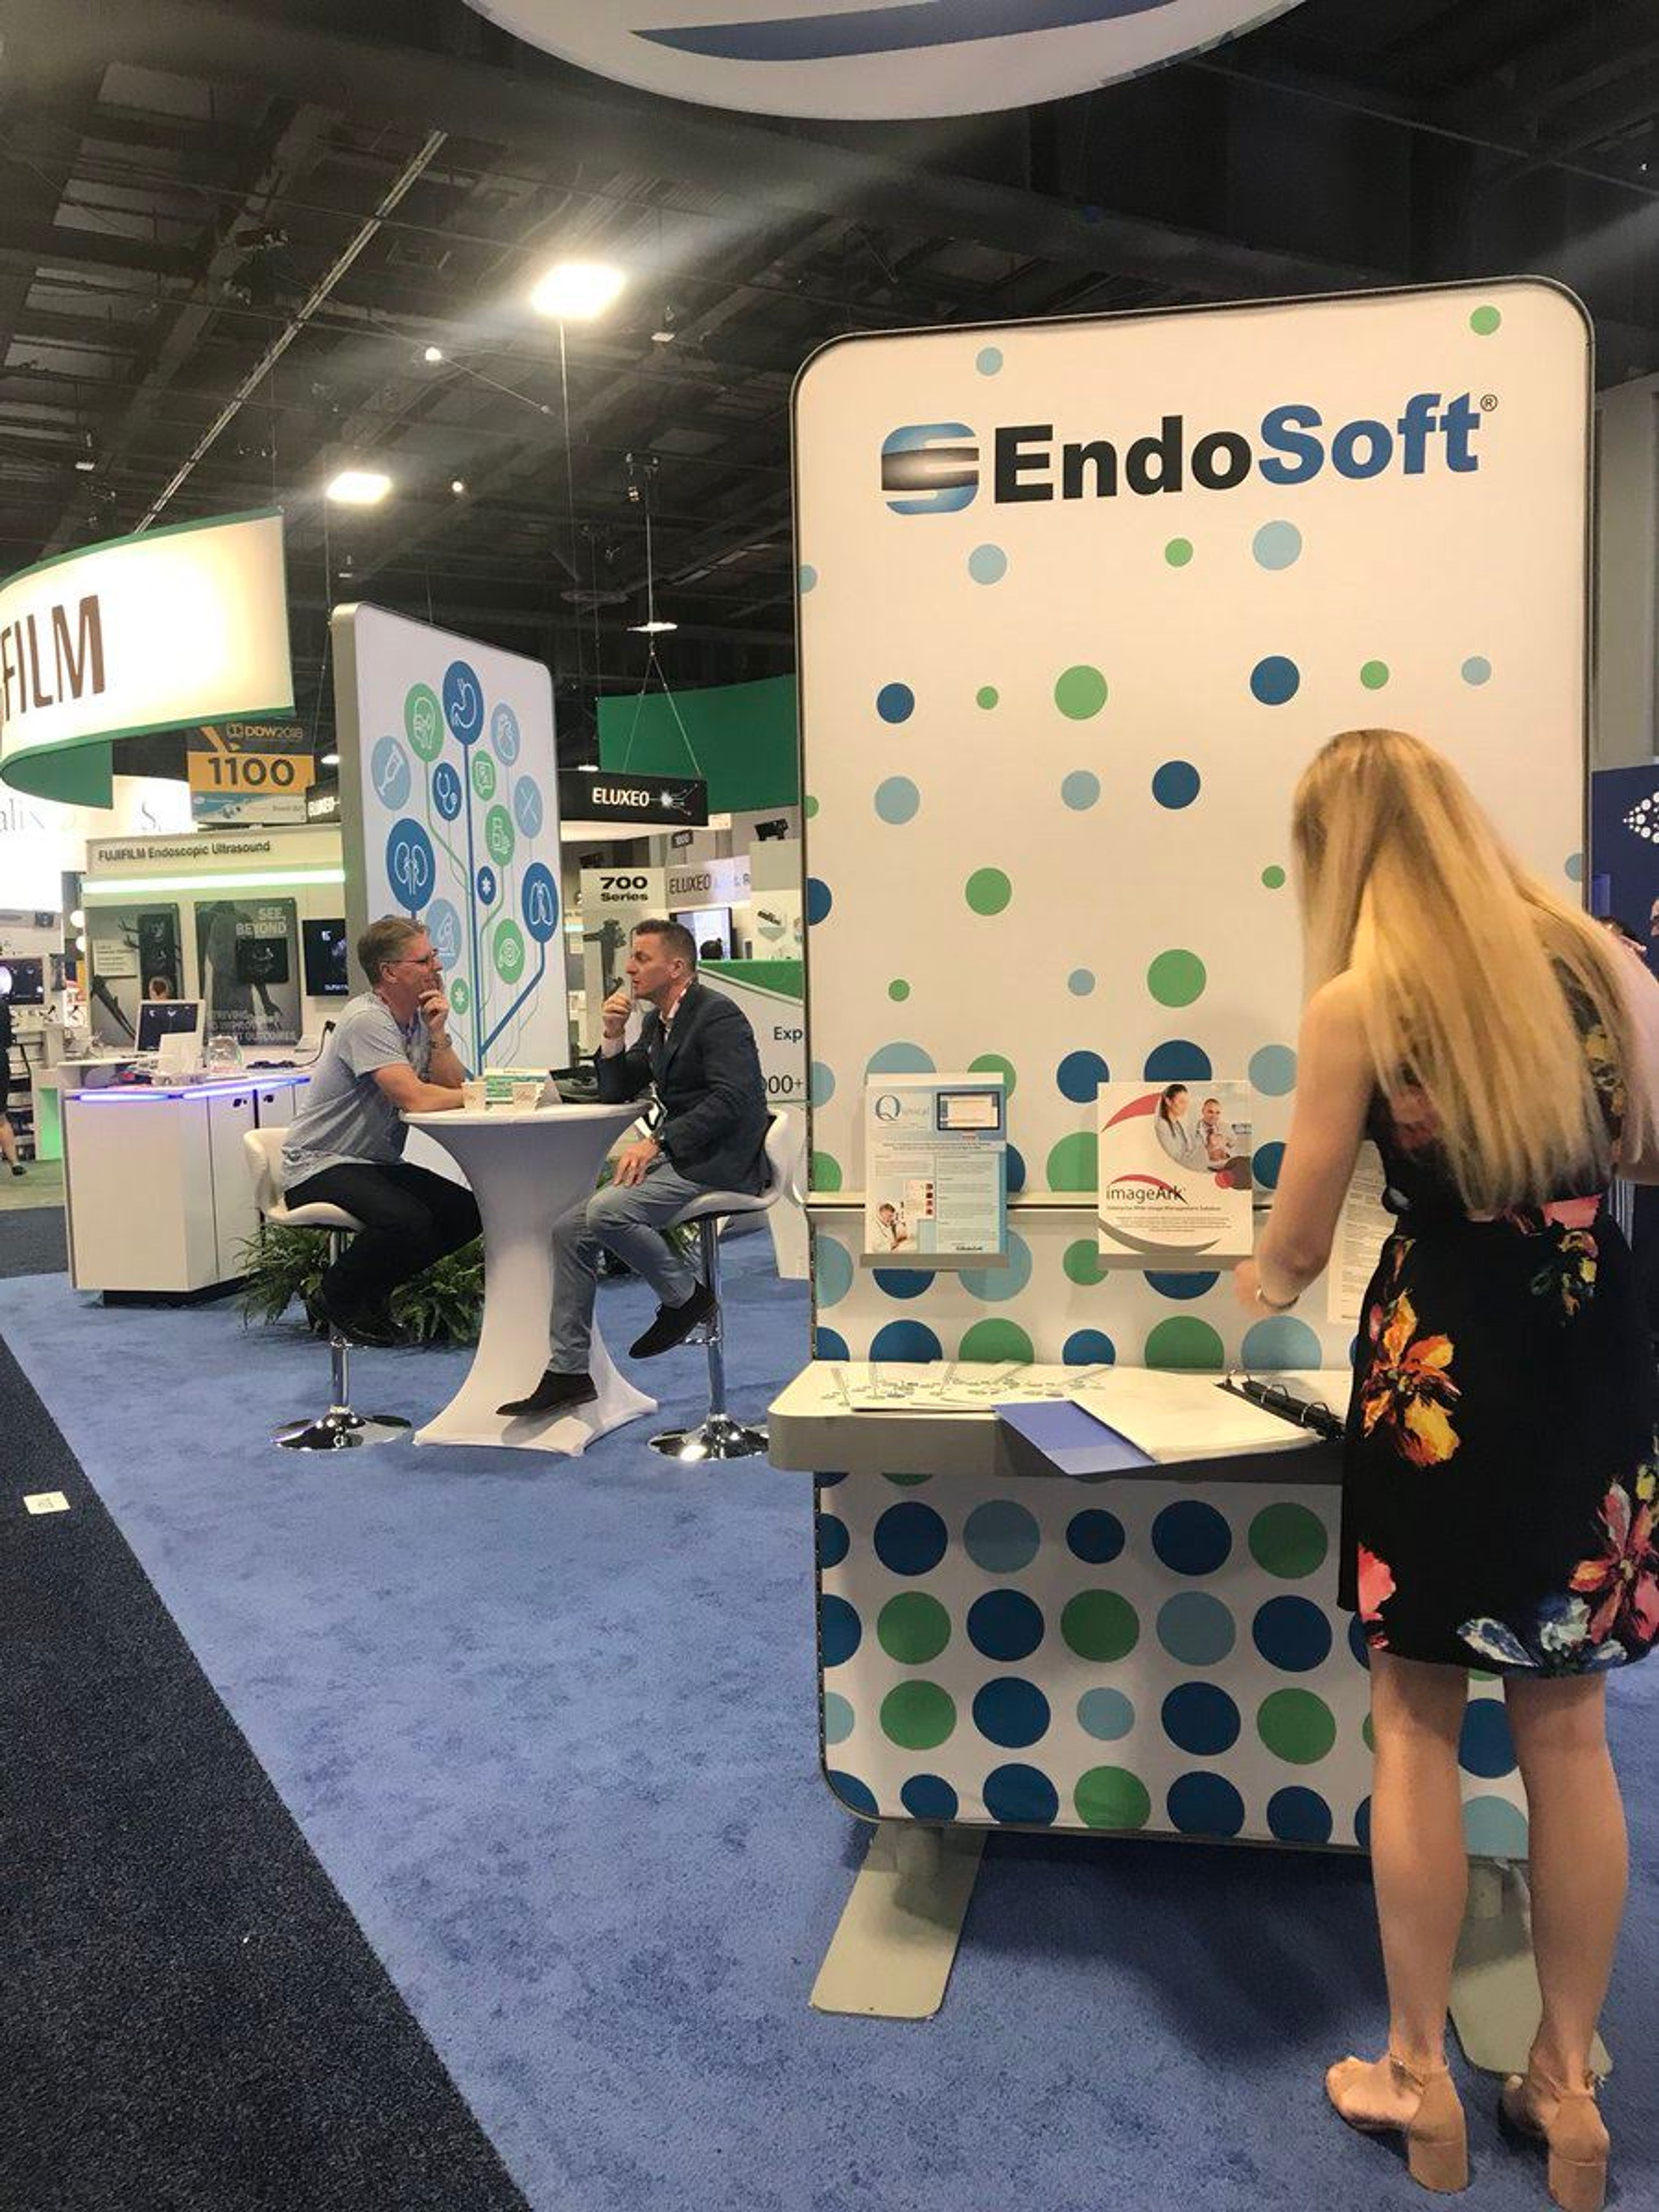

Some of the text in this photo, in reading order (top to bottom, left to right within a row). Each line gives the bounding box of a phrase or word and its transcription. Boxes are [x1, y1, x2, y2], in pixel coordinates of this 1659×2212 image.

[2, 594, 105, 721] FILM
[208, 757, 296, 786] 1100
[592, 787, 650, 807] ELUXEO
[99, 840, 270, 861] FUJIFILM Endoscopic Ultrasound
[600, 876, 648, 889] 700
[669, 873, 711, 894] ELUXEO
[601, 891, 648, 902] Series
[236, 922, 287, 936] BEYOND
[774, 1027, 803, 1043] Exp
